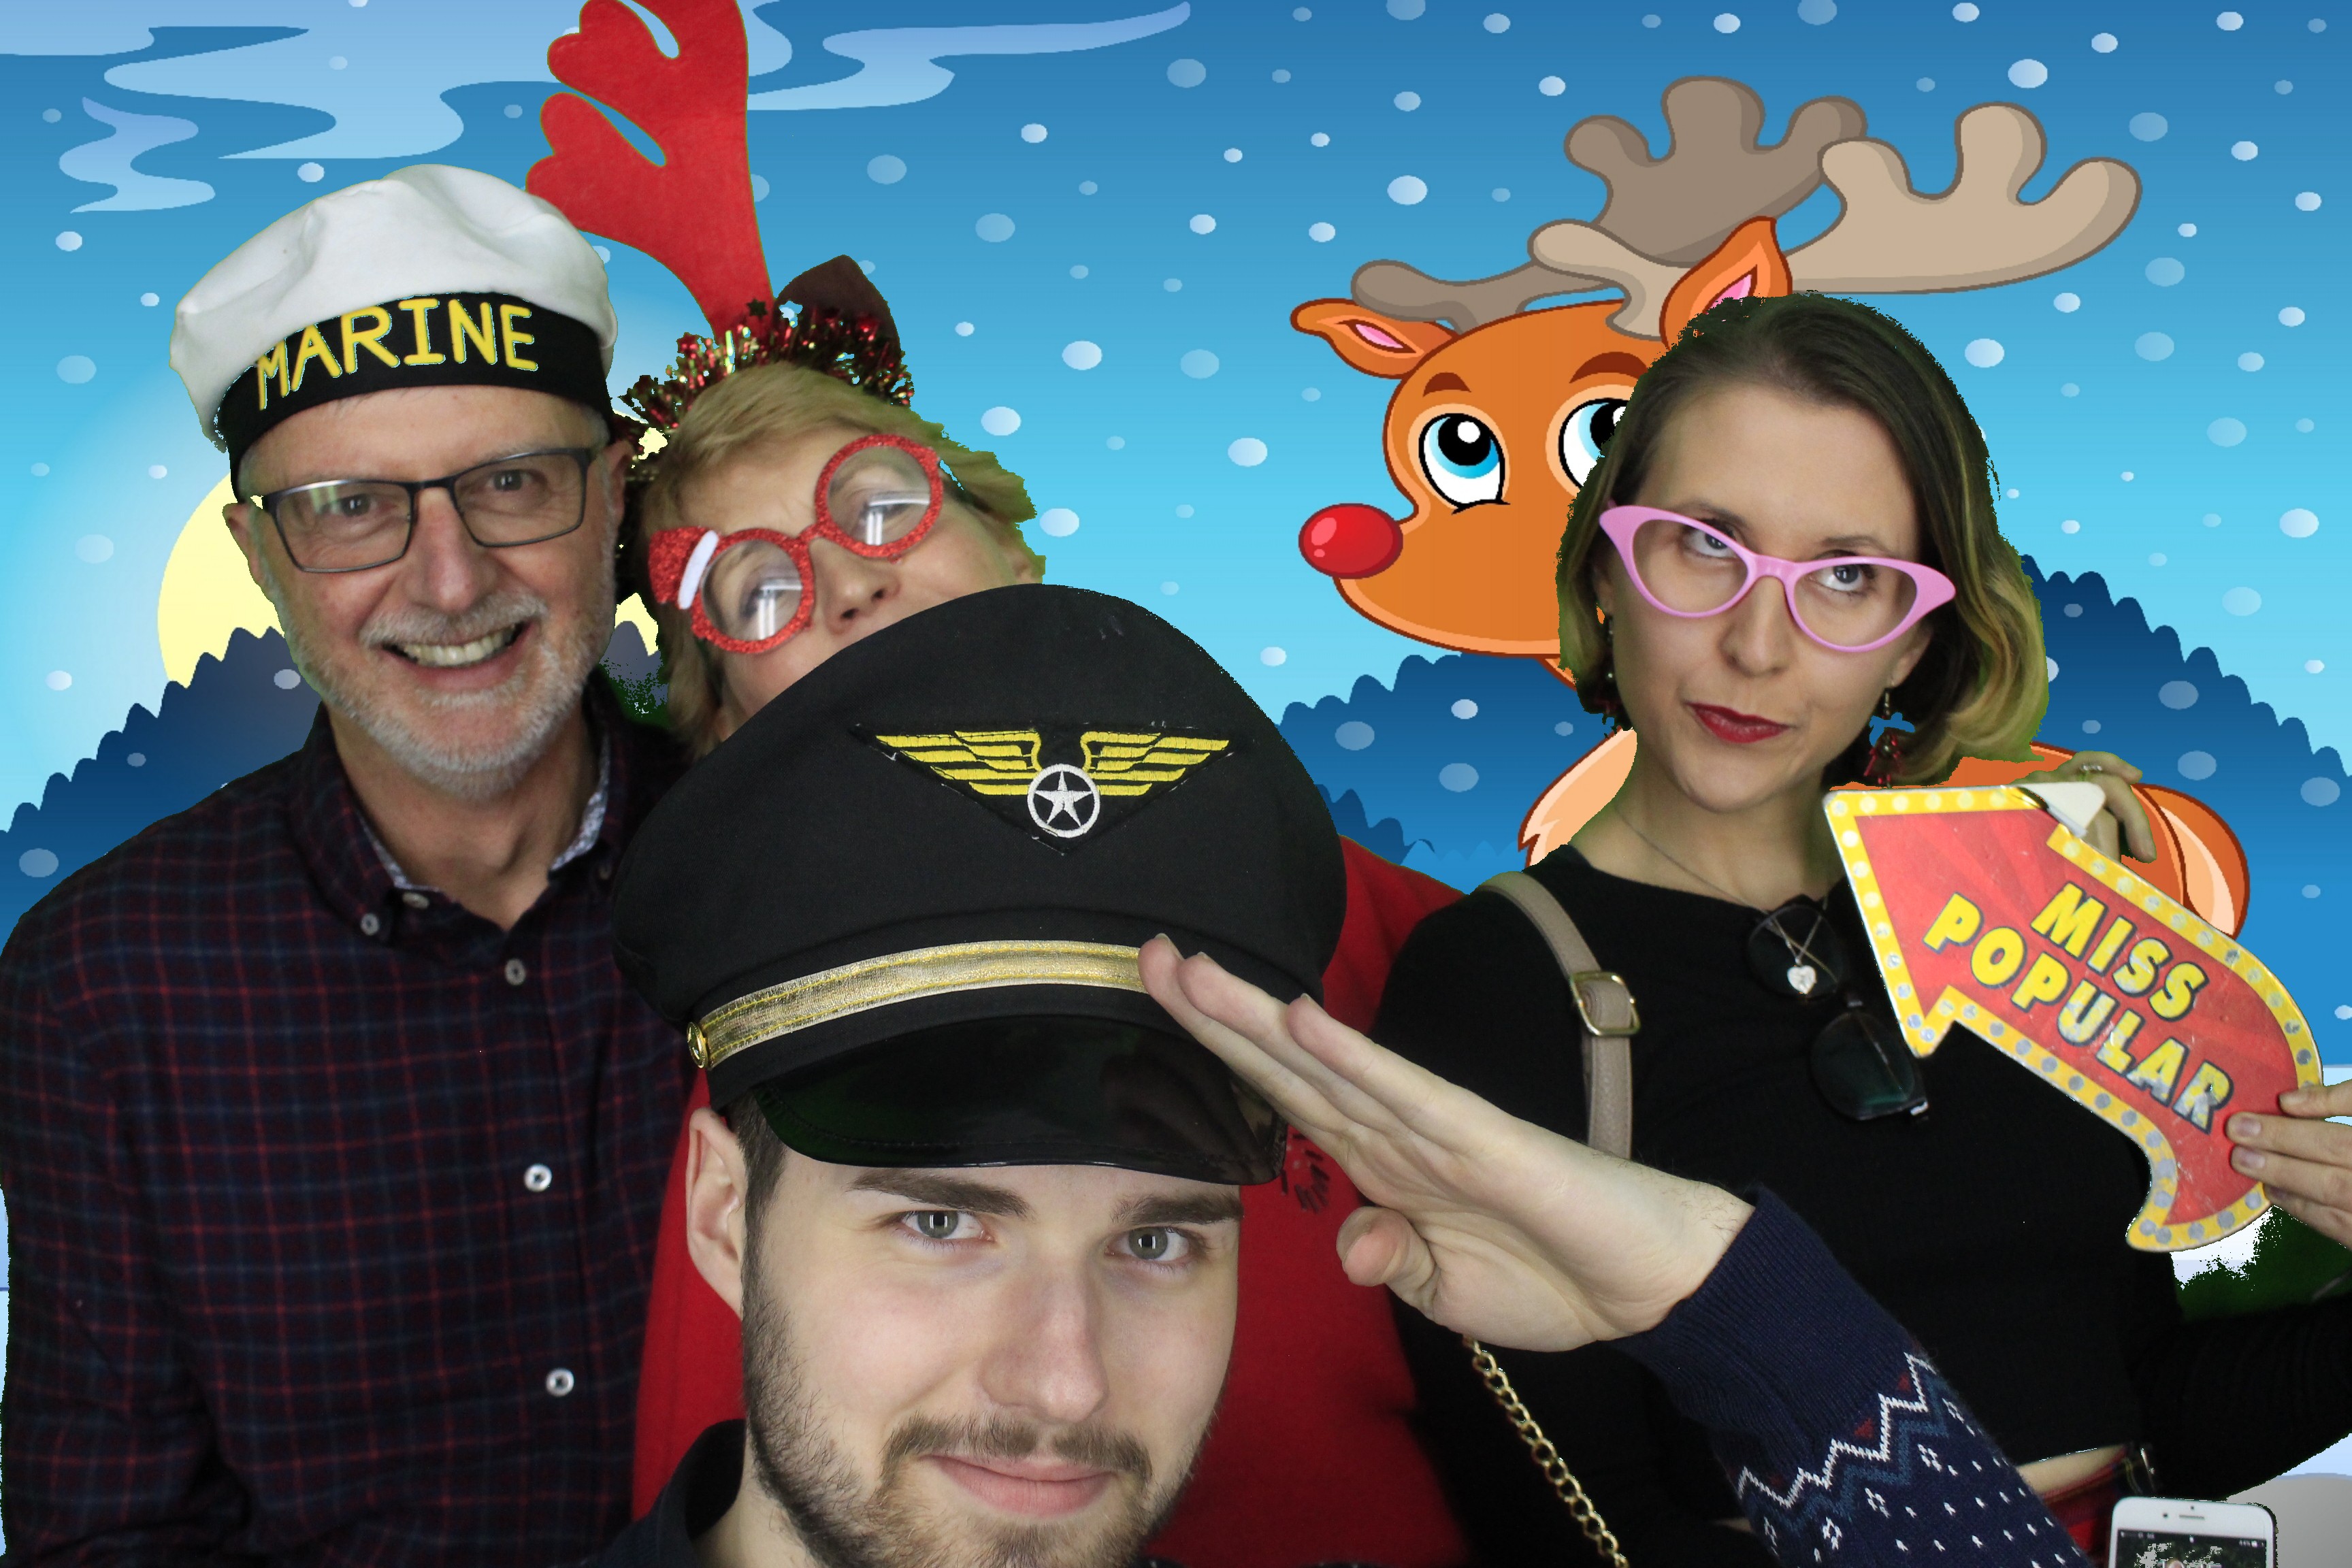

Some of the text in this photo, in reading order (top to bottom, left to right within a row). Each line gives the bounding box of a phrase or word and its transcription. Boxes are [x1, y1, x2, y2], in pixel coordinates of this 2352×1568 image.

[258, 298, 538, 410] MARINE
[1923, 892, 2234, 1134] POPULAR
[2031, 882, 2209, 1022] MISS
